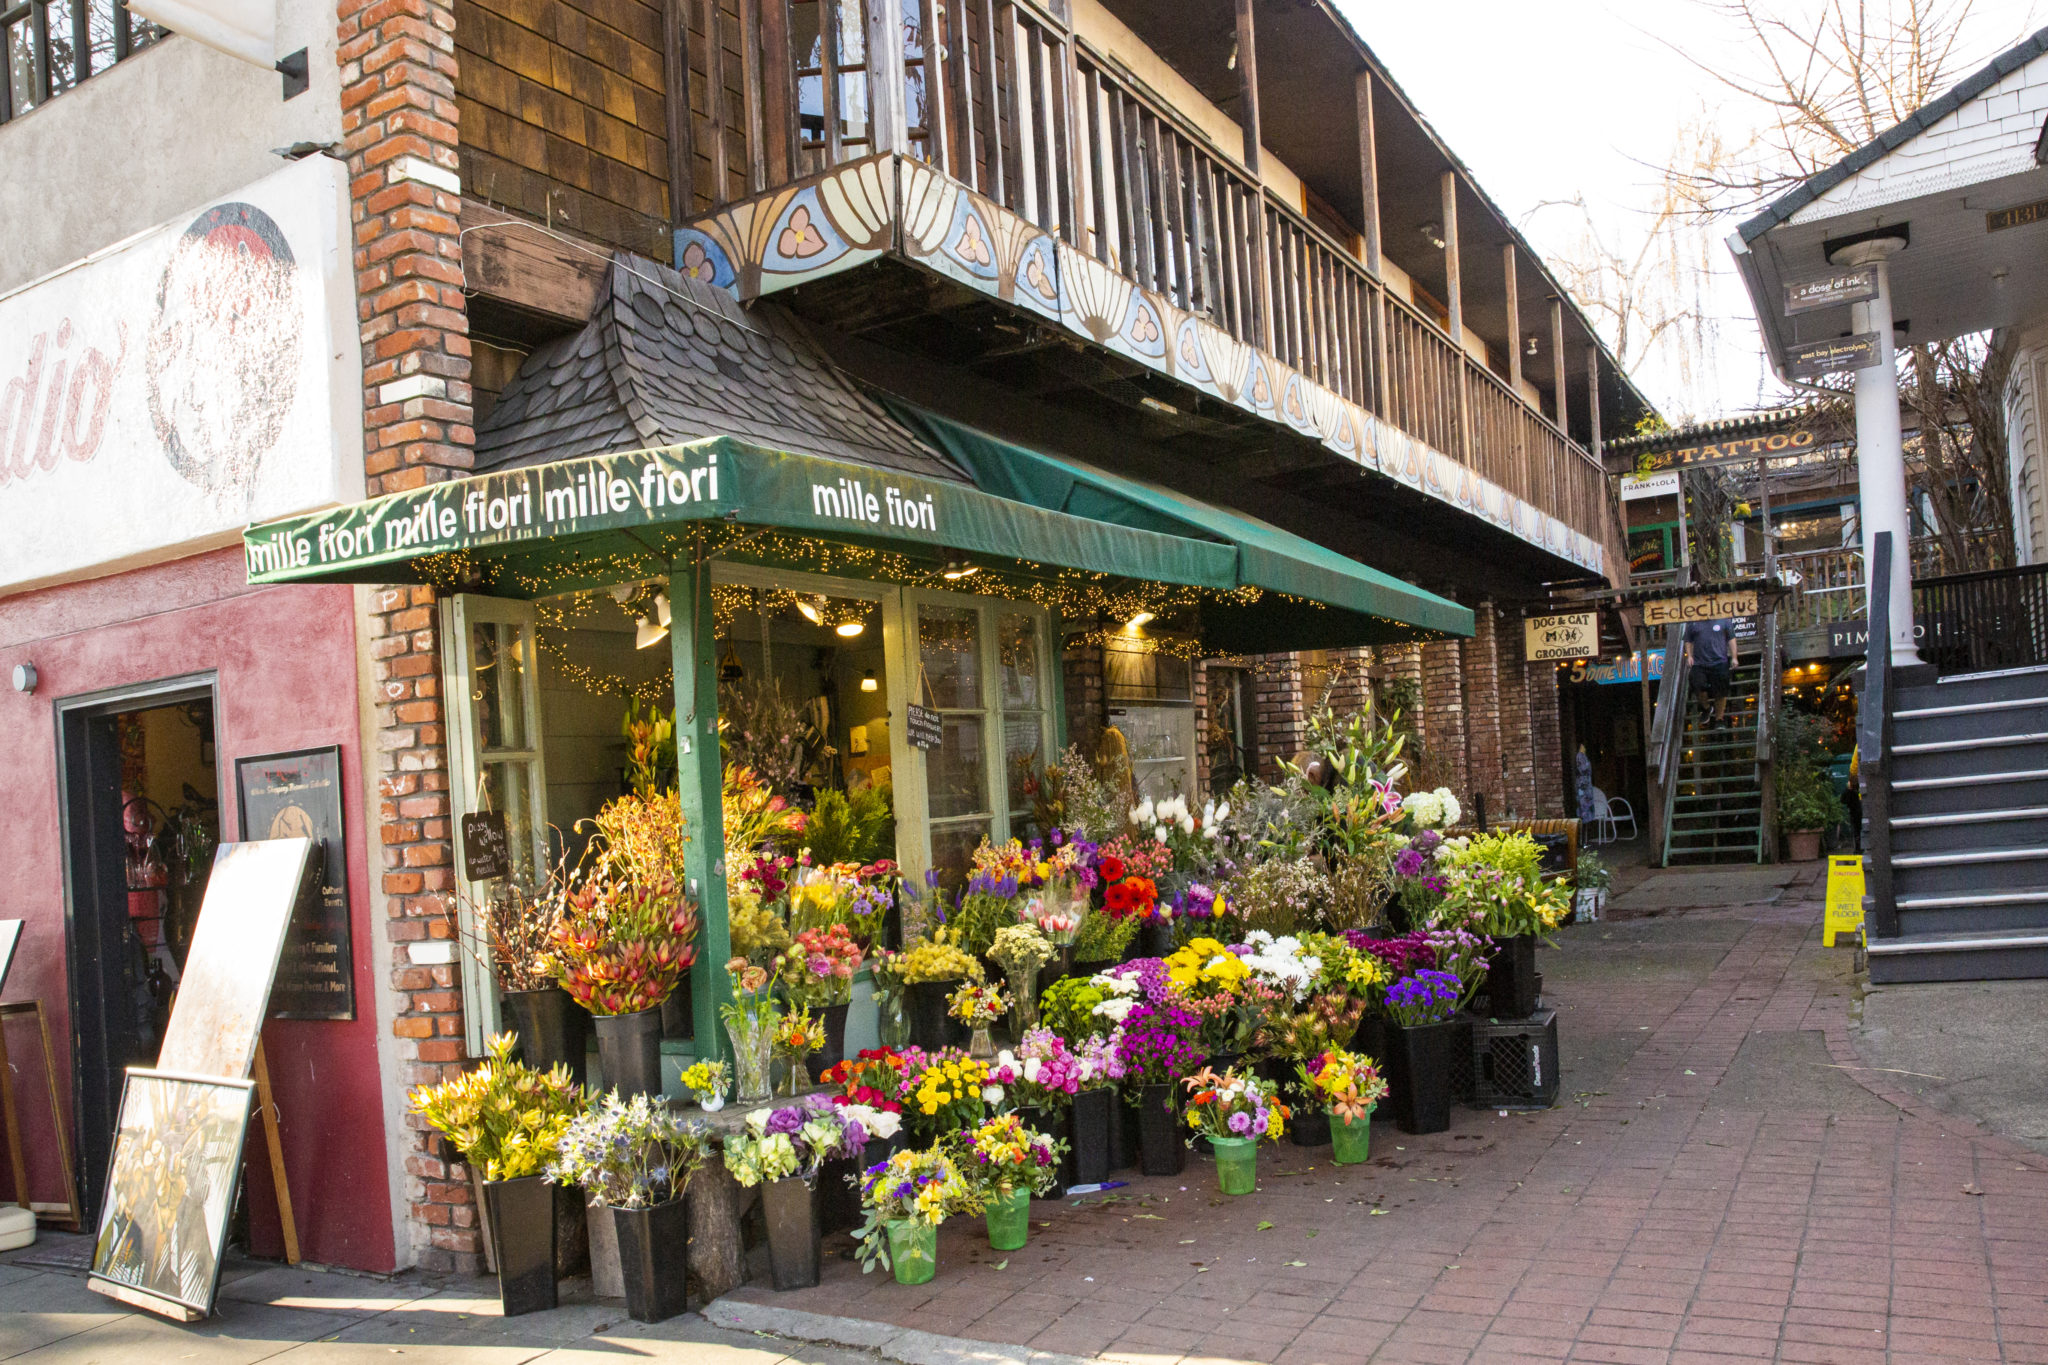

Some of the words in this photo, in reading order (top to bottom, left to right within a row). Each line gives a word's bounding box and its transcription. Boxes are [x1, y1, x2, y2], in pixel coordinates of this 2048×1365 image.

[1800, 288, 1807, 296] a
[1808, 284, 1832, 294] dose
[1834, 278, 1845, 289] of
[1846, 275, 1861, 287] ink
[1800, 351, 1815, 360] east
[1816, 349, 1829, 358] bay
[0, 317, 128, 487] dio
[1677, 430, 1814, 464] TATTOO
[248, 530, 311, 573] mille
[318, 514, 375, 563] fiori
[384, 499, 458, 550] mille
[465, 482, 532, 534] fiori
[544, 470, 631, 523] mille
[640, 453, 718, 508] fiori
[812, 477, 881, 523] mille
[885, 486, 937, 532] fiori
[1533, 616, 1556, 630] DOG
[1557, 616, 1566, 625] &
[1567, 614, 1590, 626] CAT
[1535, 645, 1590, 659] GROOMING
[1615, 656, 1665, 679] VINAG
[1832, 910, 1860, 918] FLOOR
[1836, 903, 1855, 911] WET
[329, 980, 346, 993] More
